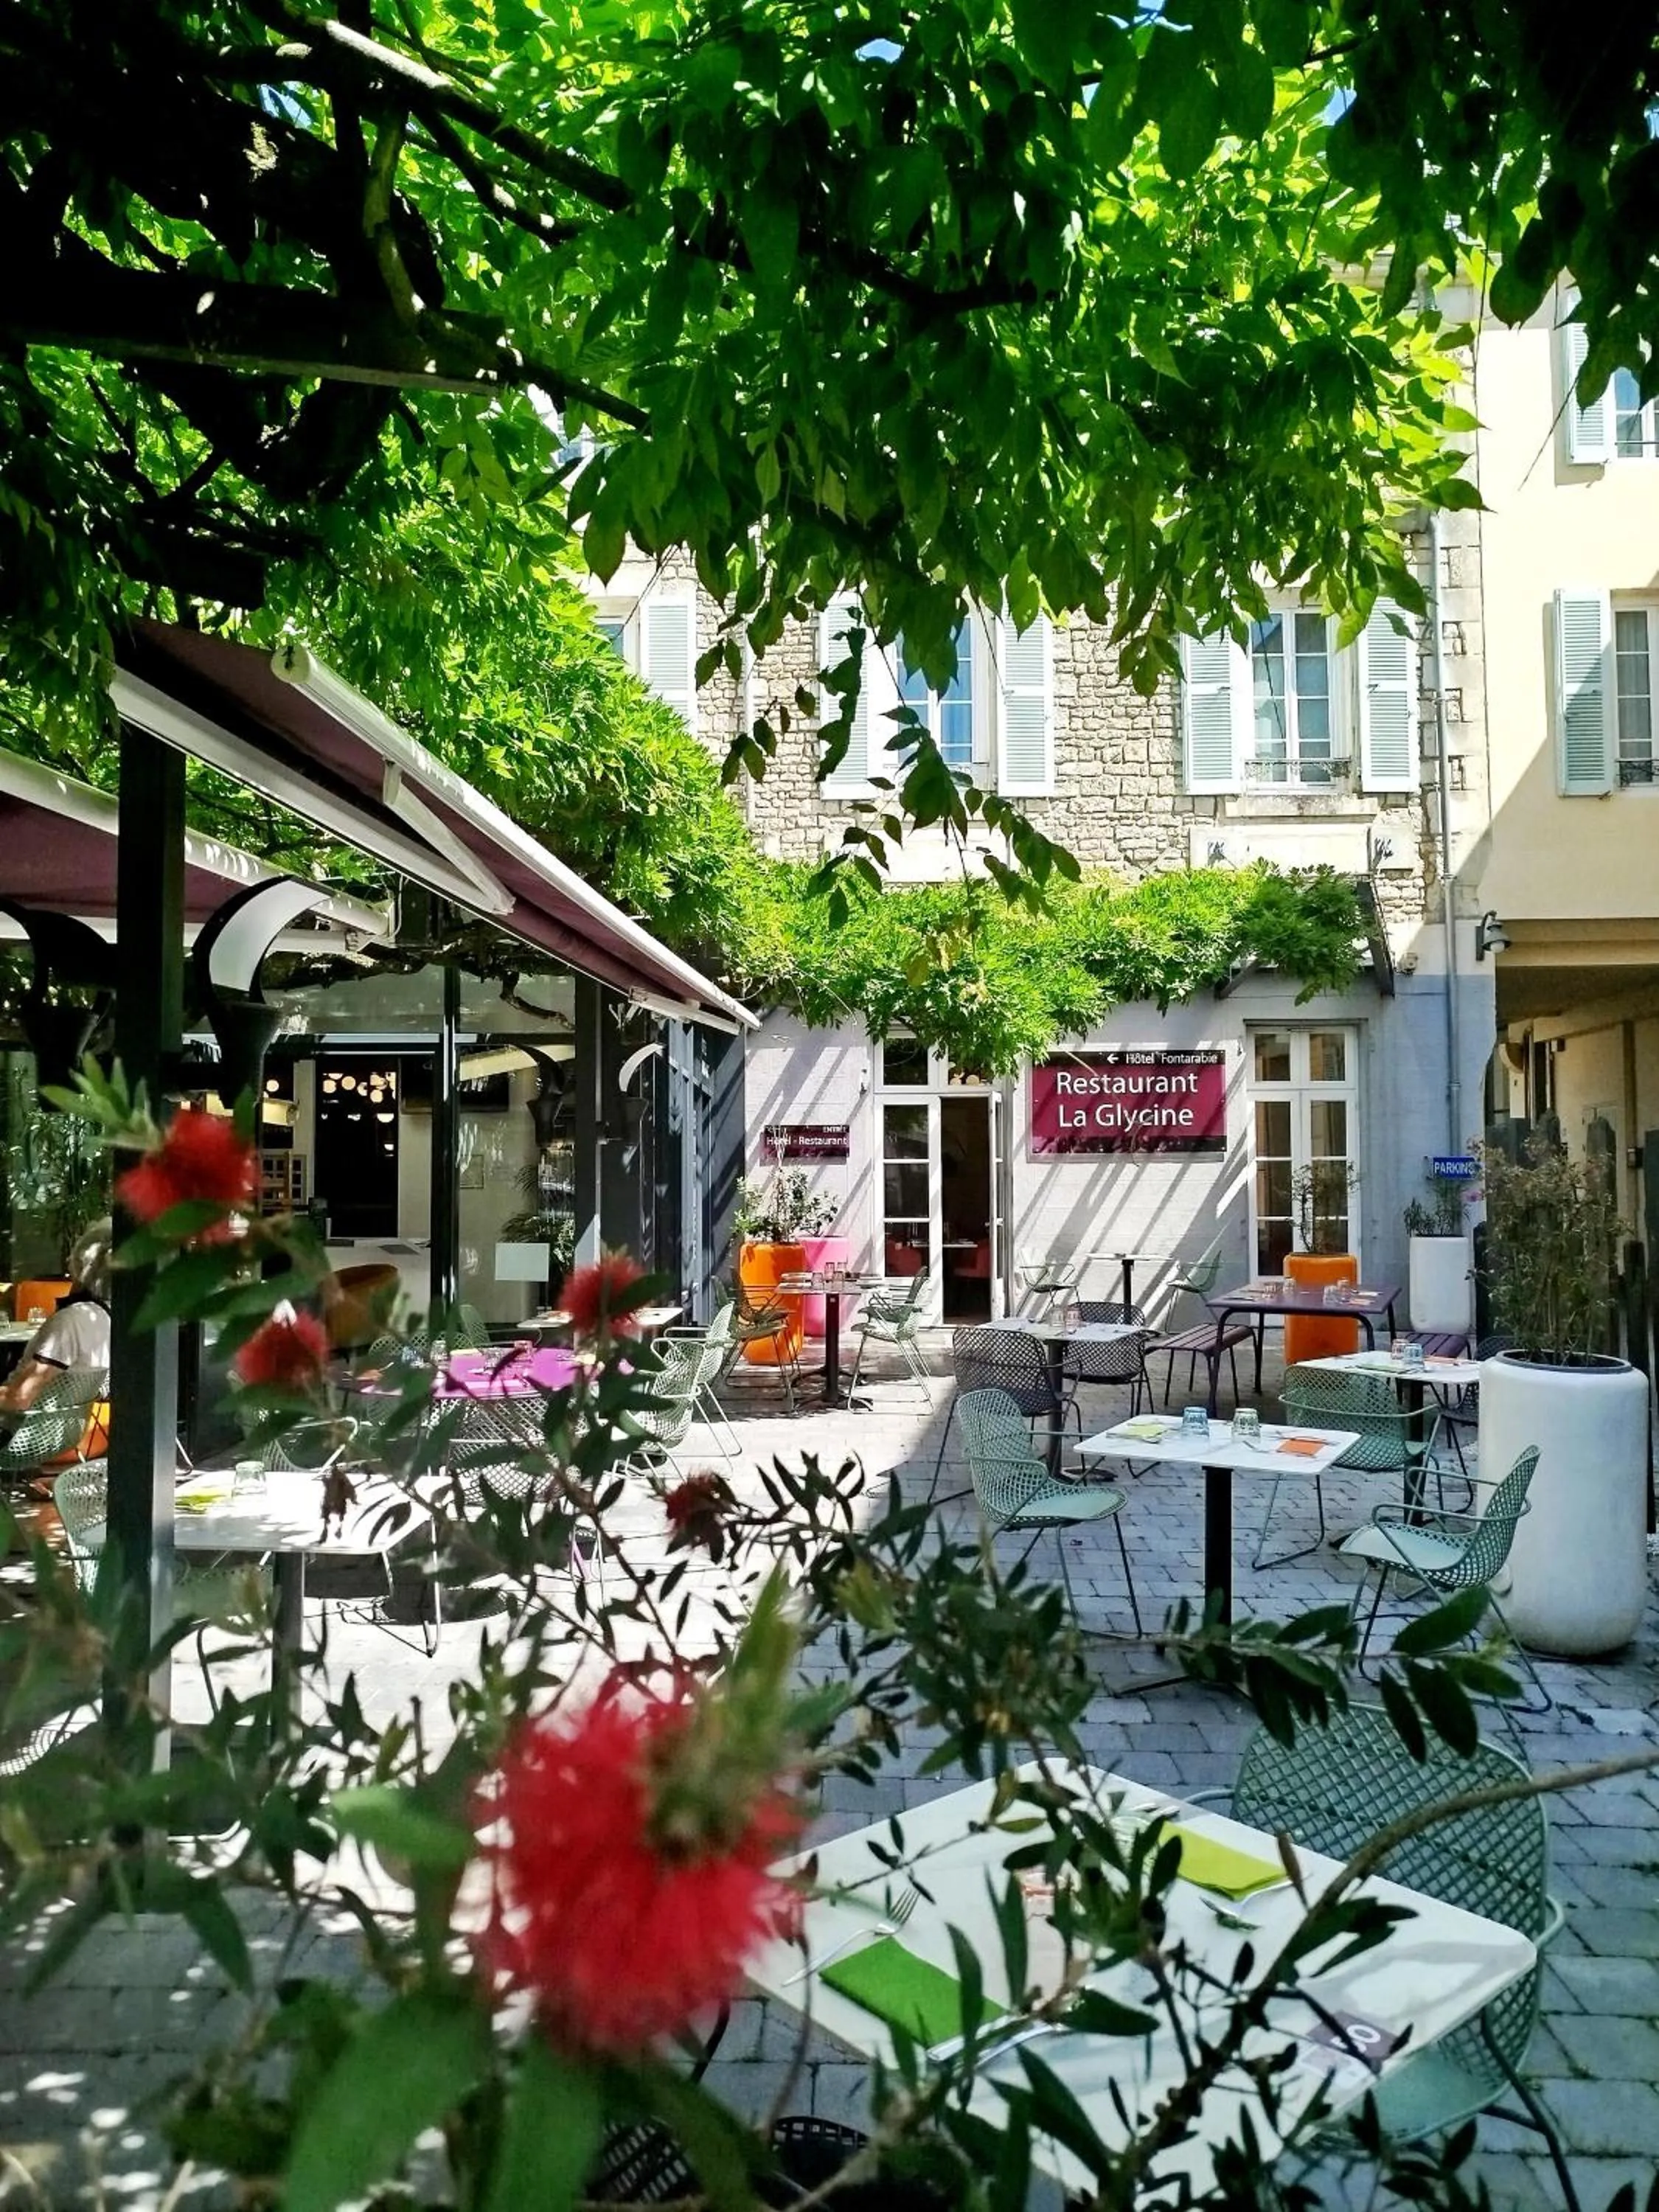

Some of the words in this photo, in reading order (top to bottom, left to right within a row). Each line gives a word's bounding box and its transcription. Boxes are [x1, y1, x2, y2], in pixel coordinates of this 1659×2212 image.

[1126, 1052, 1155, 1064] Hôtel
[1161, 1052, 1218, 1064] Fontarabie
[1057, 1071, 1198, 1094] Restaurant
[1059, 1105, 1086, 1127] La
[1096, 1103, 1194, 1133] Glycine
[799, 1136, 847, 1145] Restaurant
